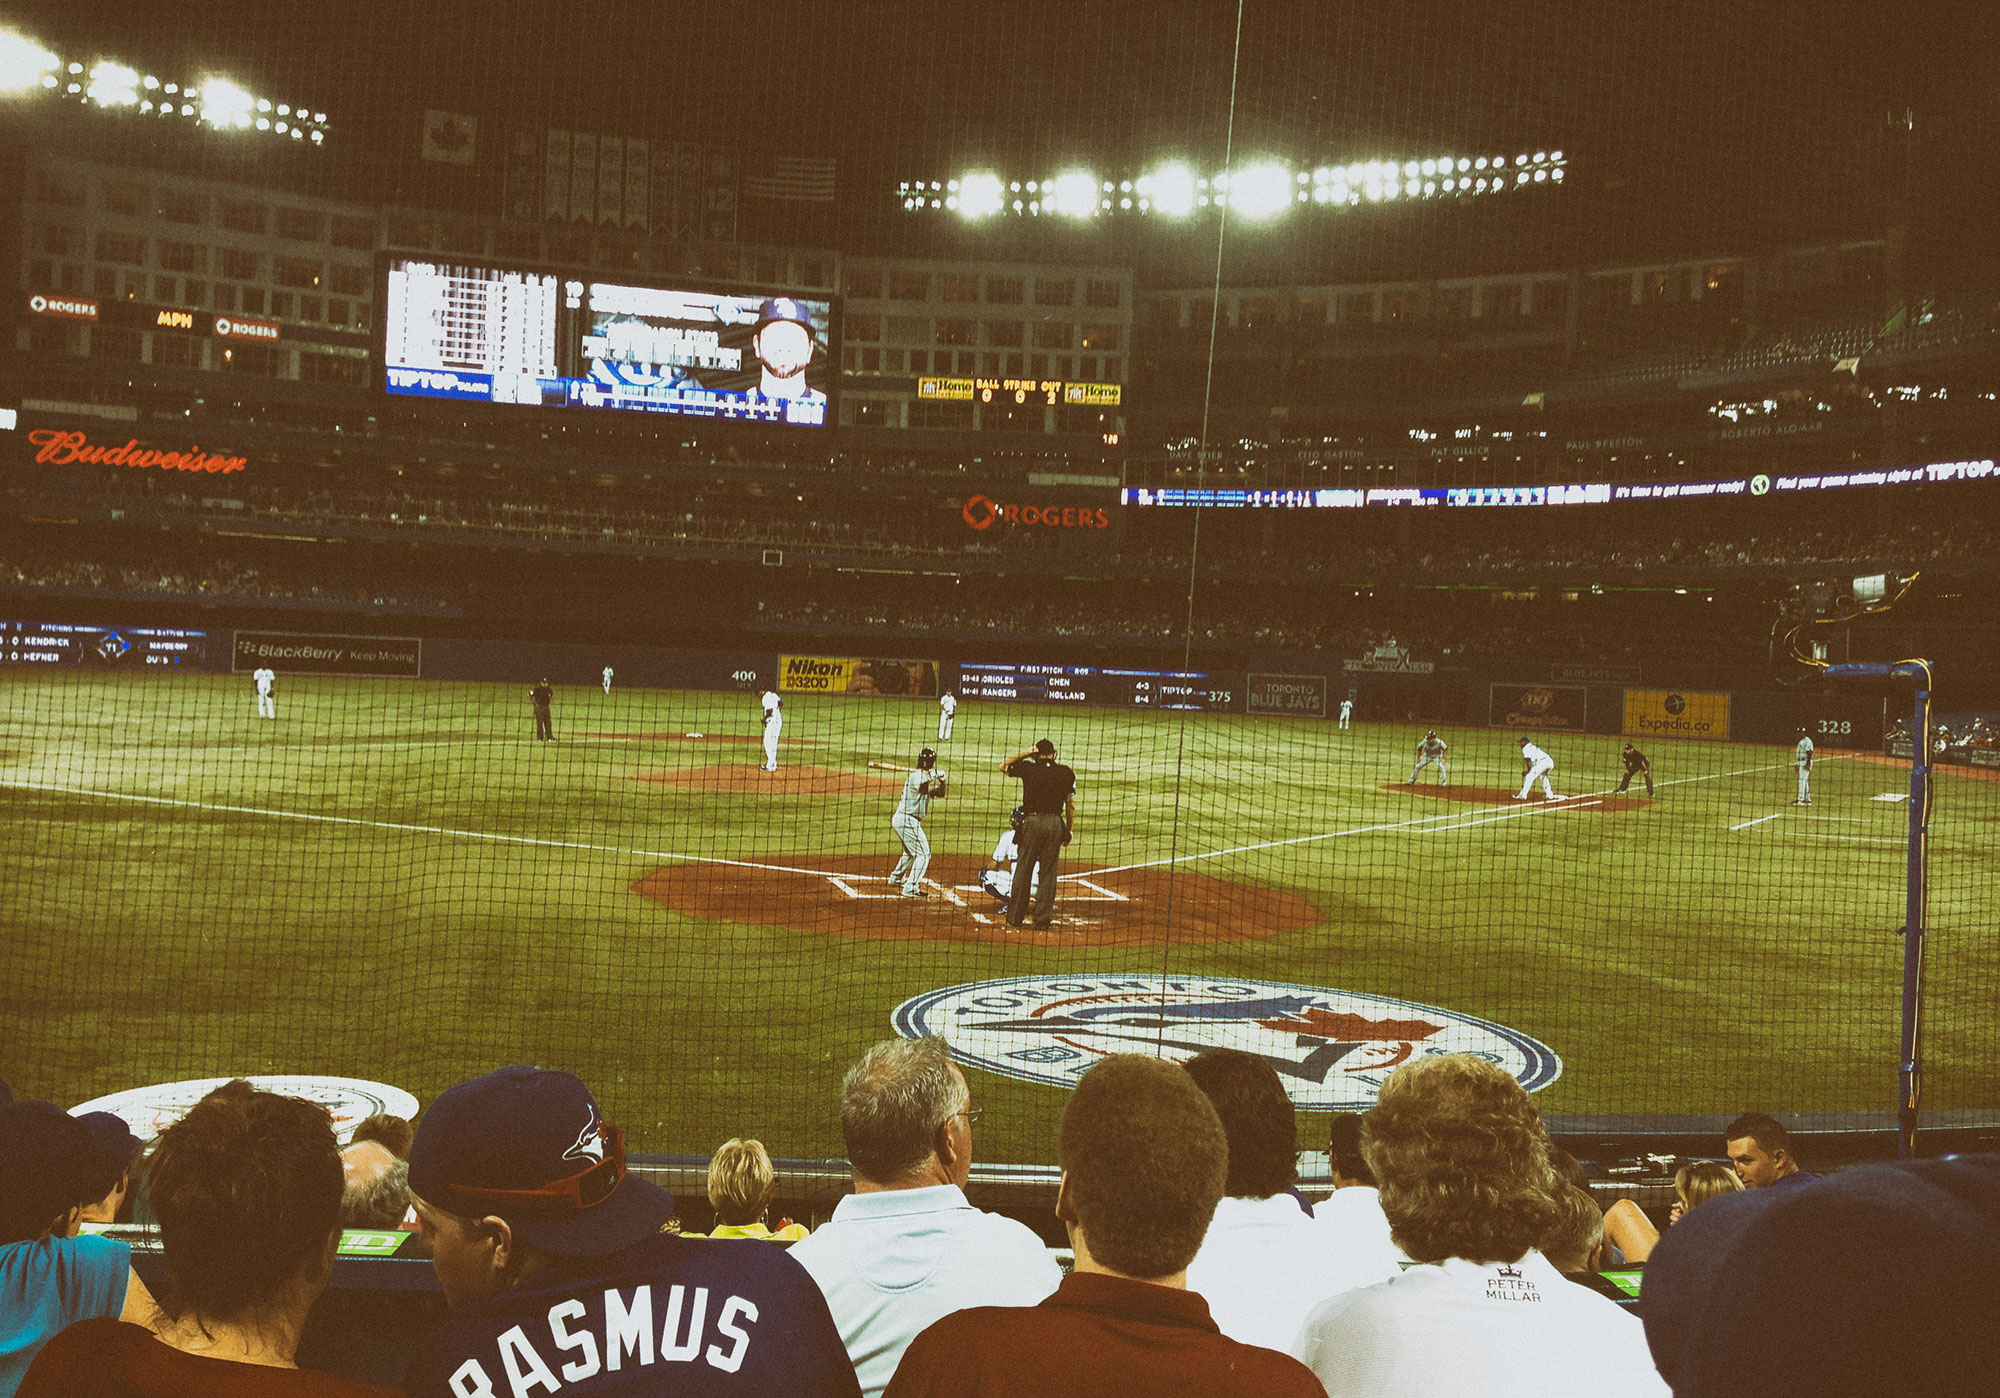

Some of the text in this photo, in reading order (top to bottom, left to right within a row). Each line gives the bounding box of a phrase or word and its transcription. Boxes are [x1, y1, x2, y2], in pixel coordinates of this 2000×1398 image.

[48, 300, 96, 316] ROGERS
[157, 311, 193, 328] MPH
[232, 322, 278, 338] ROGERS
[938, 379, 972, 391] Home
[976, 378, 1062, 393] BALL STRIKE OUT
[1085, 384, 1119, 396] Home
[982, 389, 992, 402] 0
[1015, 391, 1026, 404] 0
[1047, 392, 1056, 405] 2
[1720, 421, 1823, 441] ROBERTO ALOMAR
[28, 428, 247, 475] Budweiser
[1431, 446, 1490, 457] PAT GILLICK
[1566, 441, 1590, 450] PAUL
[1169, 450, 1192, 460] DAVE
[1298, 450, 1364, 460] CITO GASTON
[1776, 477, 1796, 489] Find
[1797, 477, 1820, 490] your
[1820, 474, 1848, 488] game
[1849, 471, 1886, 485] winning
[1887, 468, 1911, 484] style
[1911, 467, 1923, 480] at
[1926, 460, 1994, 481] TIPTOP
[1663, 484, 1678, 498] get
[1716, 480, 1745, 494] ready!
[1004, 504, 1109, 529] ROGERS
[41, 624, 73, 633] PITCHING
[24, 636, 70, 647] KENDRICK
[258, 643, 415, 664] BlackBerry Keep Moving
[787, 658, 843, 677] Nikon
[1020, 665, 1040, 674] FIRST
[1041, 666, 1063, 675] PITCH
[732, 670, 756, 682] 400
[786, 676, 829, 689] D3200
[982, 675, 1014, 684] ORIOLES
[1049, 677, 1070, 687] CHEN
[982, 688, 1017, 698] RANGERS
[1049, 691, 1086, 700] HOLLAND
[1266, 683, 1314, 694] TORONTO
[1208, 691, 1231, 703] 375
[1250, 693, 1320, 710] BLUE JAYS
[1638, 714, 1710, 732] Expedia.ca
[1817, 719, 1852, 735] 328
[955, 980, 1258, 1016] TORONTO
[342, 1233, 397, 1251] TD
[1487, 1278, 1536, 1291] PETER
[1486, 1289, 1542, 1303] MILLAR
[448, 1284, 760, 1398] RASMUS
